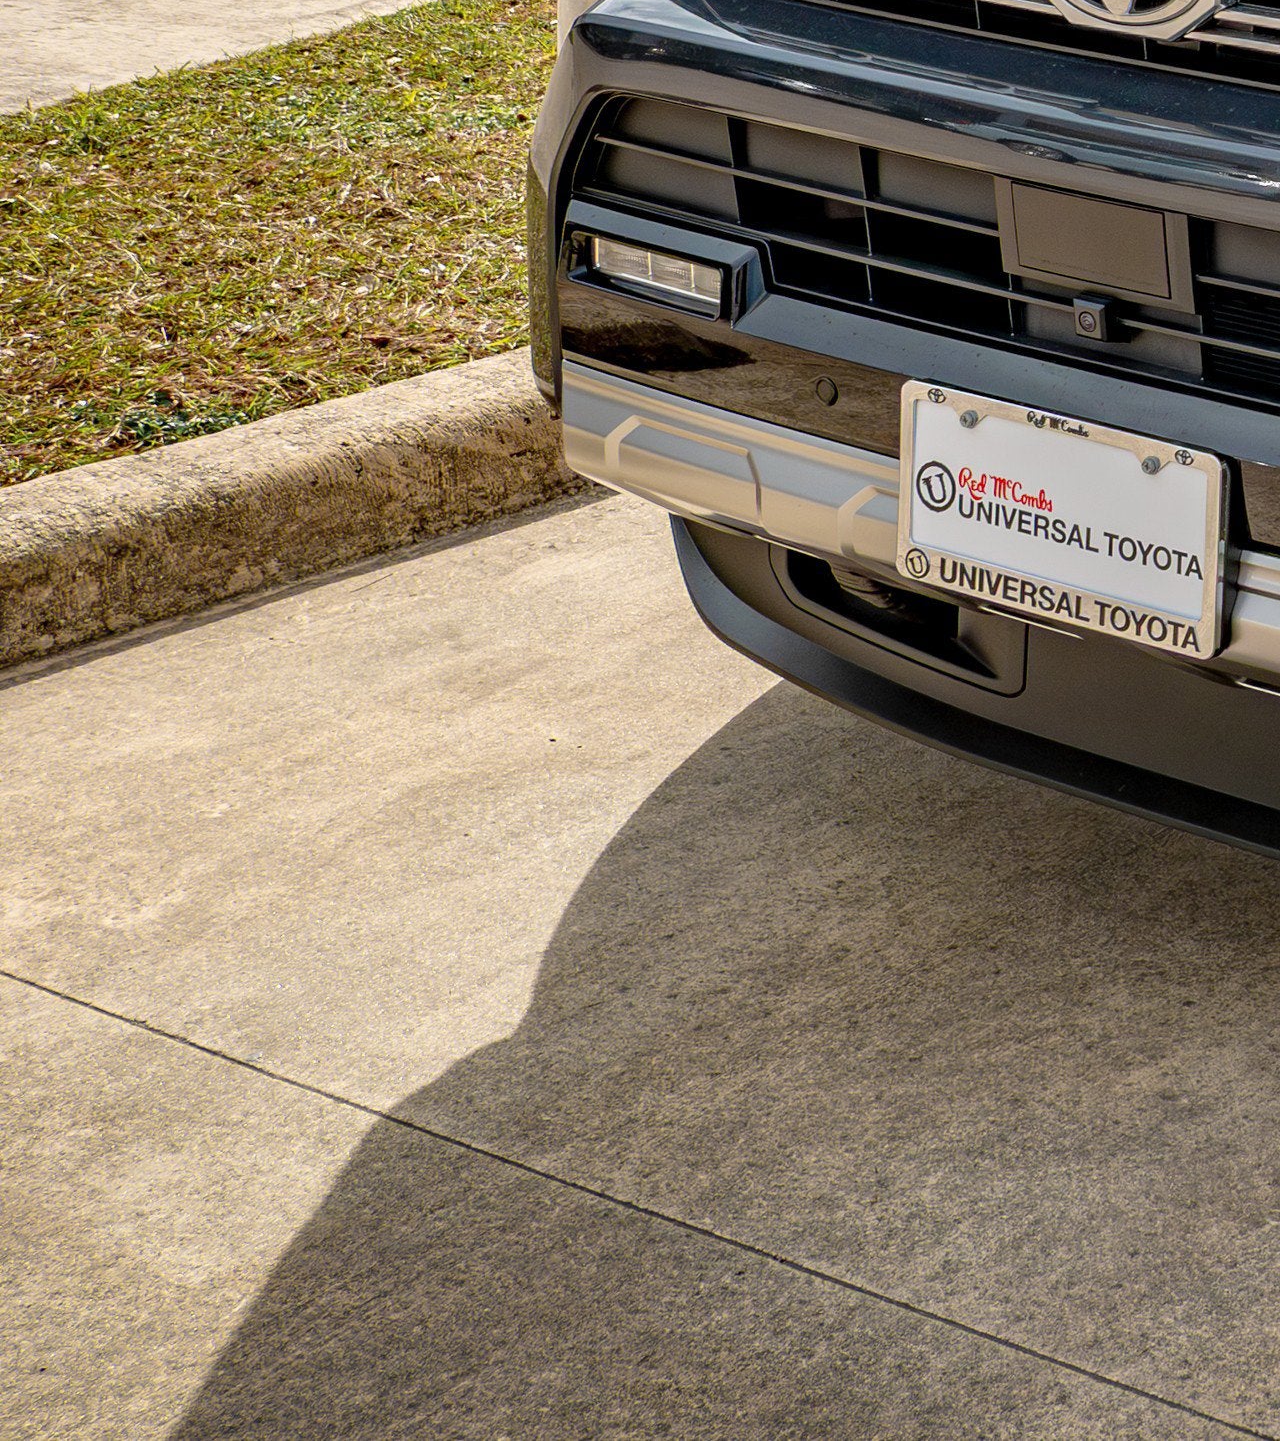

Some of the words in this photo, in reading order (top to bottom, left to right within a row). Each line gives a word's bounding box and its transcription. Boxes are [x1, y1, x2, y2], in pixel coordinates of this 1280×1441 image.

[958, 467, 987, 501] Red
[989, 474, 1053, 513] McCombs
[958, 493, 1099, 553] UNIVERSAL
[1103, 531, 1204, 580] TOYOTA
[939, 557, 1090, 622] UNIVERSAL
[1094, 599, 1200, 652] TOYOTA
